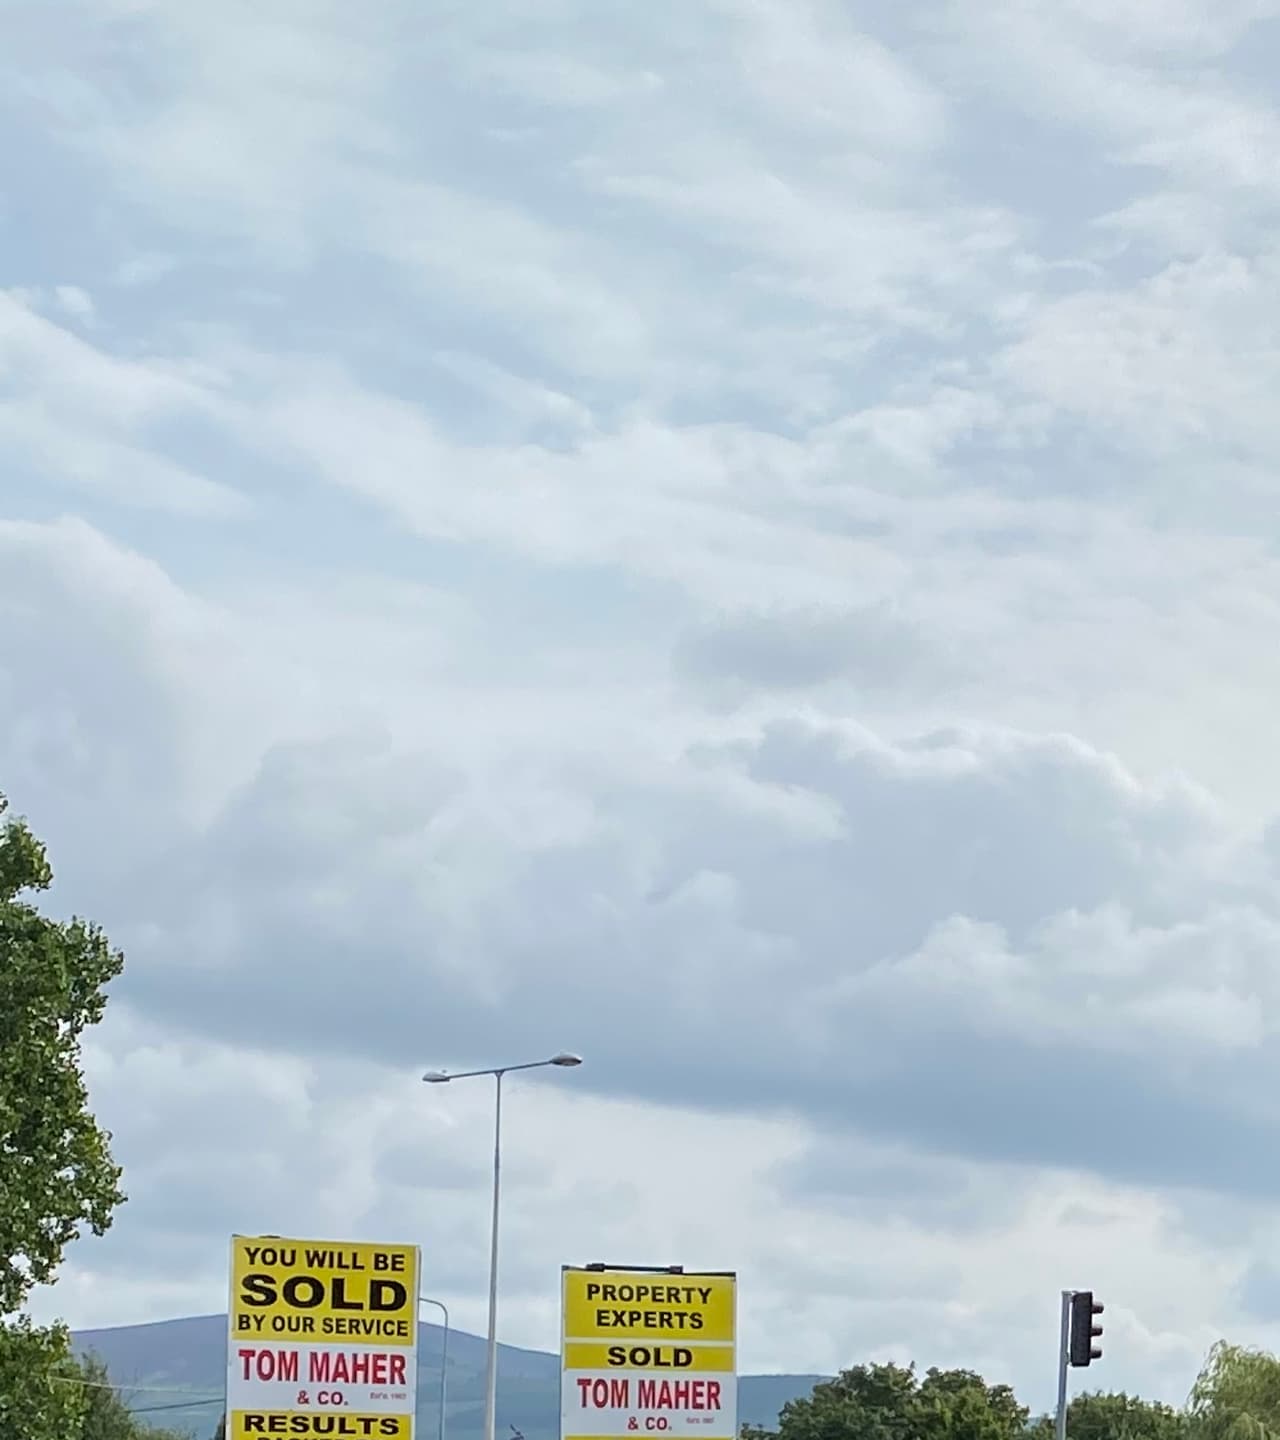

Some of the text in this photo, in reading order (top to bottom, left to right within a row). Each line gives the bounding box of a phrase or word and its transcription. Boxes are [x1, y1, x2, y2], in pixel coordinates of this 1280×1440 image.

[244, 1247, 405, 1271] YOU WILL BE
[240, 1274, 407, 1311] SOLD
[587, 1284, 712, 1304] PROPERTY
[238, 1314, 408, 1337] BY OUR SERVICE
[597, 1309, 703, 1329] EXPERTS
[239, 1349, 406, 1385] TOM MAHER
[608, 1347, 692, 1367] SOLD
[297, 1390, 348, 1405] & CO.
[577, 1378, 720, 1410] TOM MAHER
[244, 1415, 399, 1435] RESULTS
[628, 1416, 638, 1430] &
[645, 1417, 672, 1431] CO.
